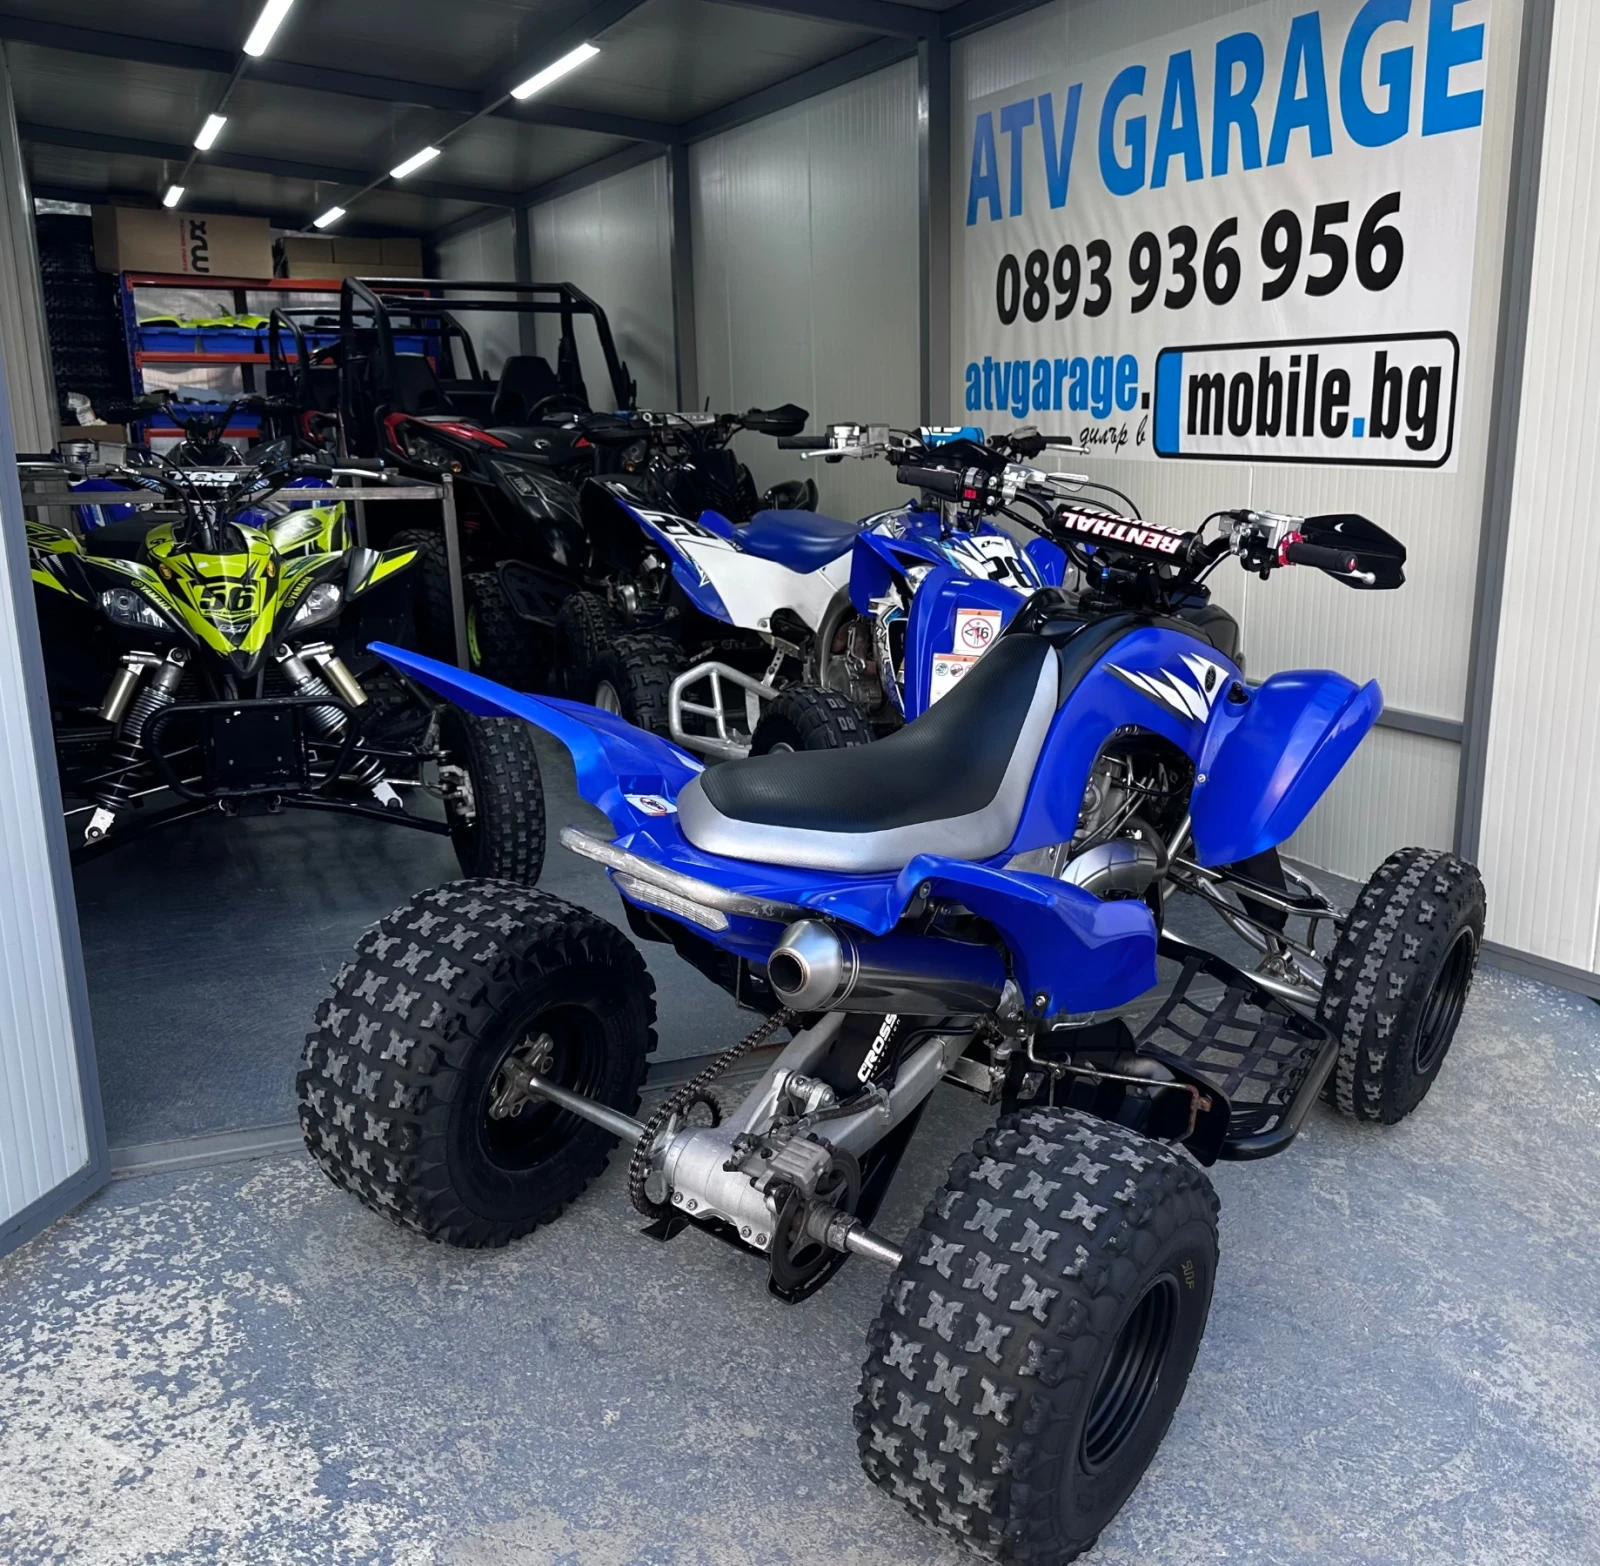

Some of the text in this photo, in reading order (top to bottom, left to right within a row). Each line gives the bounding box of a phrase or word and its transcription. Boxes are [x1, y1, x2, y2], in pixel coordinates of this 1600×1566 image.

[966, 0, 1485, 226] ATV GARAGE
[996, 191, 1404, 325] 0893 936 956
[1187, 350, 1442, 451] mobile.bg
[1079, 414, 1149, 456] дилър в
[1062, 511, 1182, 554] RENTHAL
[140, 585, 171, 611] YAMAHA
[199, 582, 257, 611] 56
[292, 576, 315, 600] YAMAHA
[857, 1013, 898, 1083] CROSS
